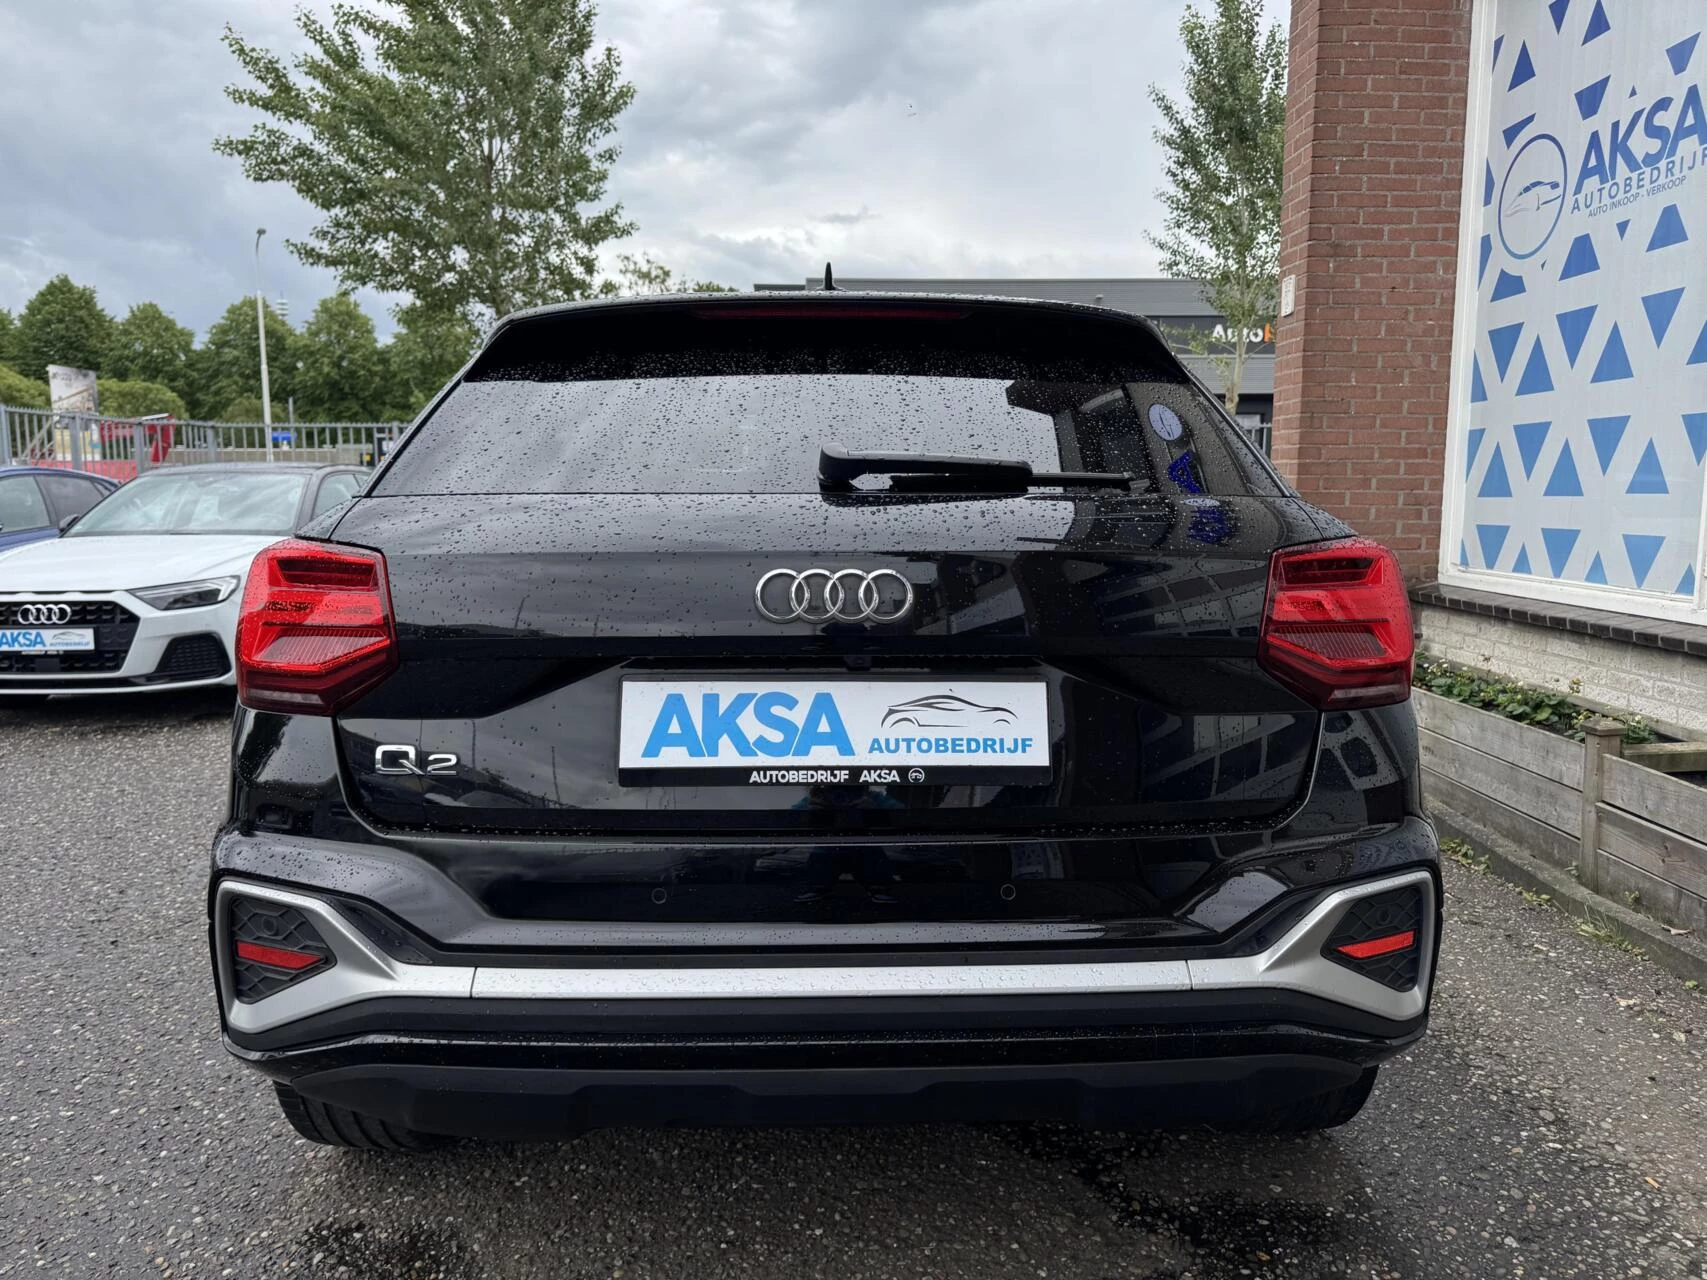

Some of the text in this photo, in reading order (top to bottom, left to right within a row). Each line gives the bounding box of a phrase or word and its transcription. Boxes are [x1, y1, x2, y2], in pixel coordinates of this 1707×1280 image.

[1572, 83, 1707, 197] AKSA
[1588, 204, 1609, 218] AUTO
[1609, 192, 1640, 210] INKOOP
[1646, 175, 1687, 197] VERKOOP
[0, 631, 46, 648] AKSA
[641, 690, 856, 758] AKSA
[375, 744, 458, 775] Q2
[868, 737, 1034, 754] AUTOBEDRIJF
[749, 769, 900, 784] AUTOBEDRIJF AKSA
